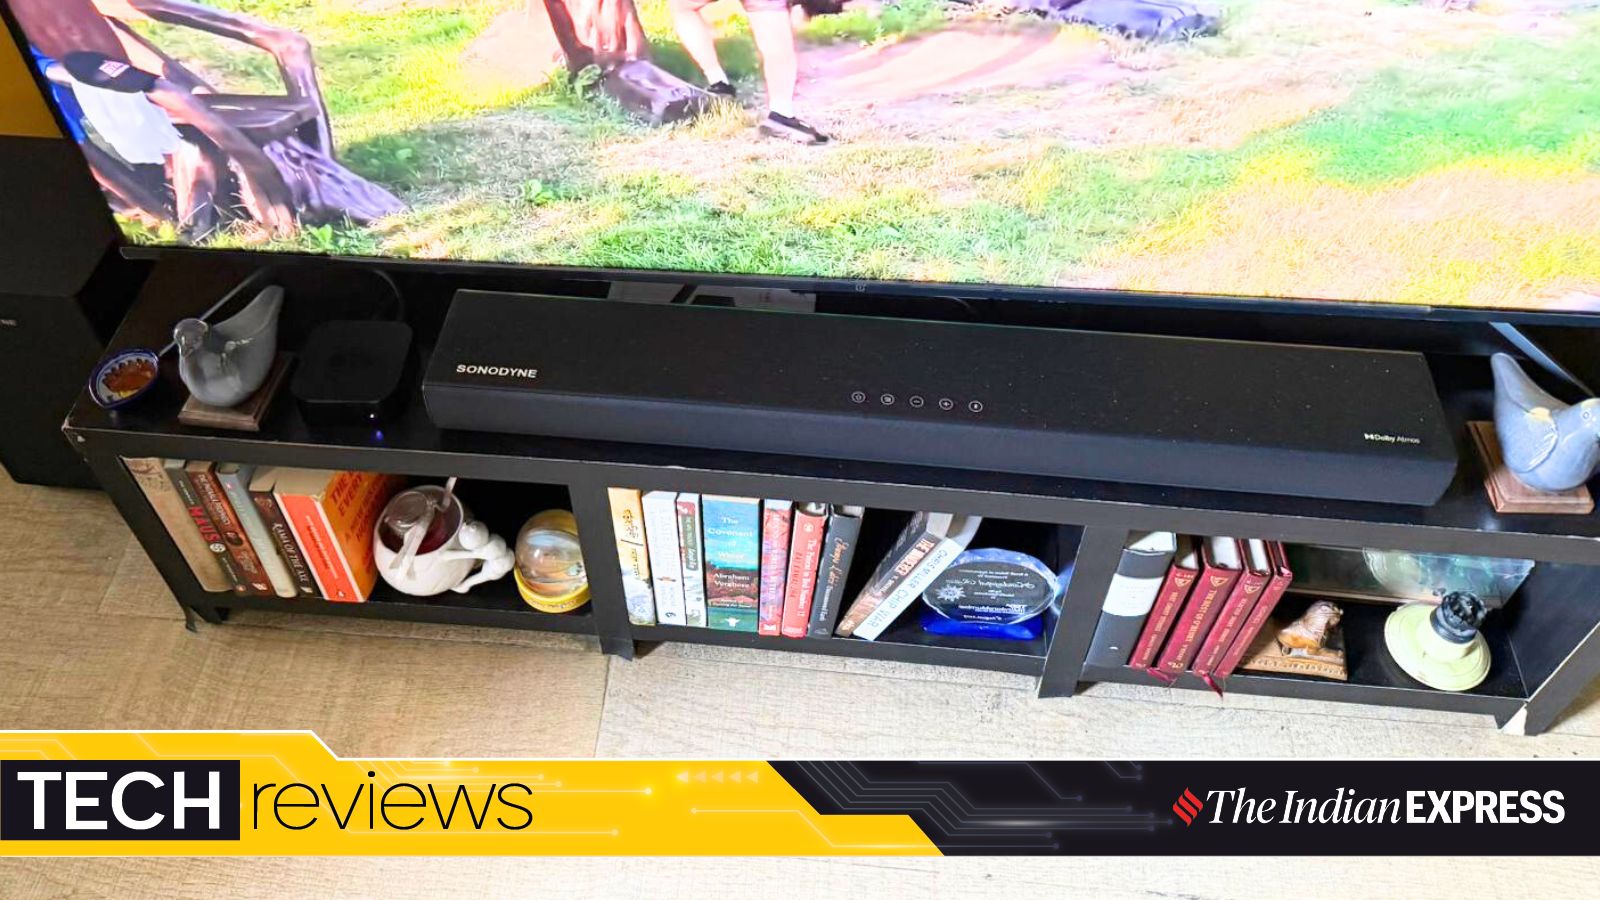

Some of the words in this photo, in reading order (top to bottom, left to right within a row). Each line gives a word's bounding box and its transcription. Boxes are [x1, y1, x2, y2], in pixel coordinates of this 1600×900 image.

[456, 364, 538, 379] SONODYNE
[1374, 433, 1396, 444] Dolby
[188, 505, 222, 543] MAUS
[722, 516, 739, 525] The
[708, 527, 754, 537] Covenant
[925, 546, 948, 571] CHRIS
[713, 573, 751, 581] Abraham
[906, 564, 931, 590] MILLER
[885, 586, 909, 611] CHIP
[866, 606, 889, 630] WAR
